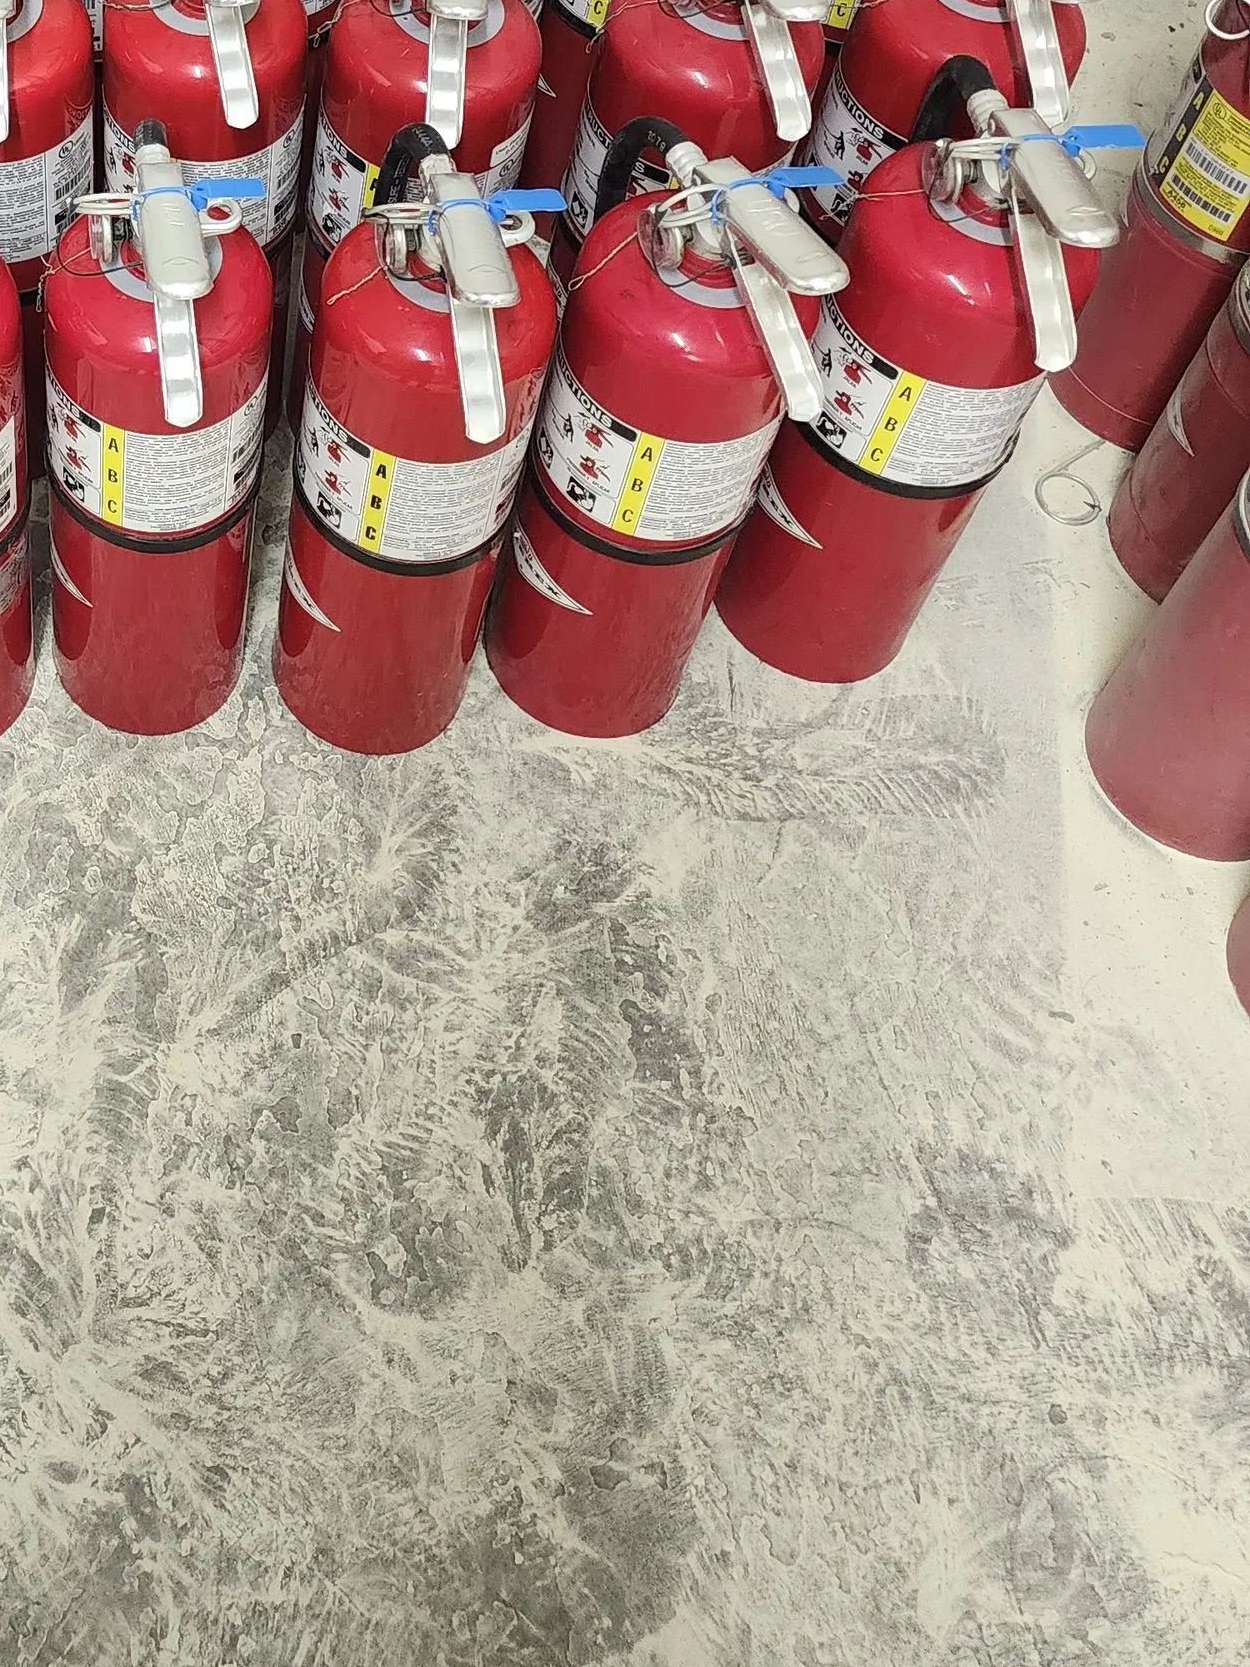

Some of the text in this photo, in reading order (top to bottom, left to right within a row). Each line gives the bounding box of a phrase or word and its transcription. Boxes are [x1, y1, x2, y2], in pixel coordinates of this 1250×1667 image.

[594, 1, 603, 15] C
[836, 2, 848, 18] C
[1193, 91, 1204, 110] A
[1175, 124, 1187, 142] B
[1158, 156, 1169, 174] C
[898, 386, 912, 403] A
[883, 416, 897, 433] B
[108, 438, 120, 453] A
[639, 447, 653, 463] A
[870, 446, 885, 463] C
[107, 468, 118, 484] B
[375, 463, 387, 480] A
[631, 477, 644, 492] B
[107, 499, 118, 514] C
[370, 494, 382, 511] B
[621, 508, 635, 524] C
[364, 525, 377, 542] C
